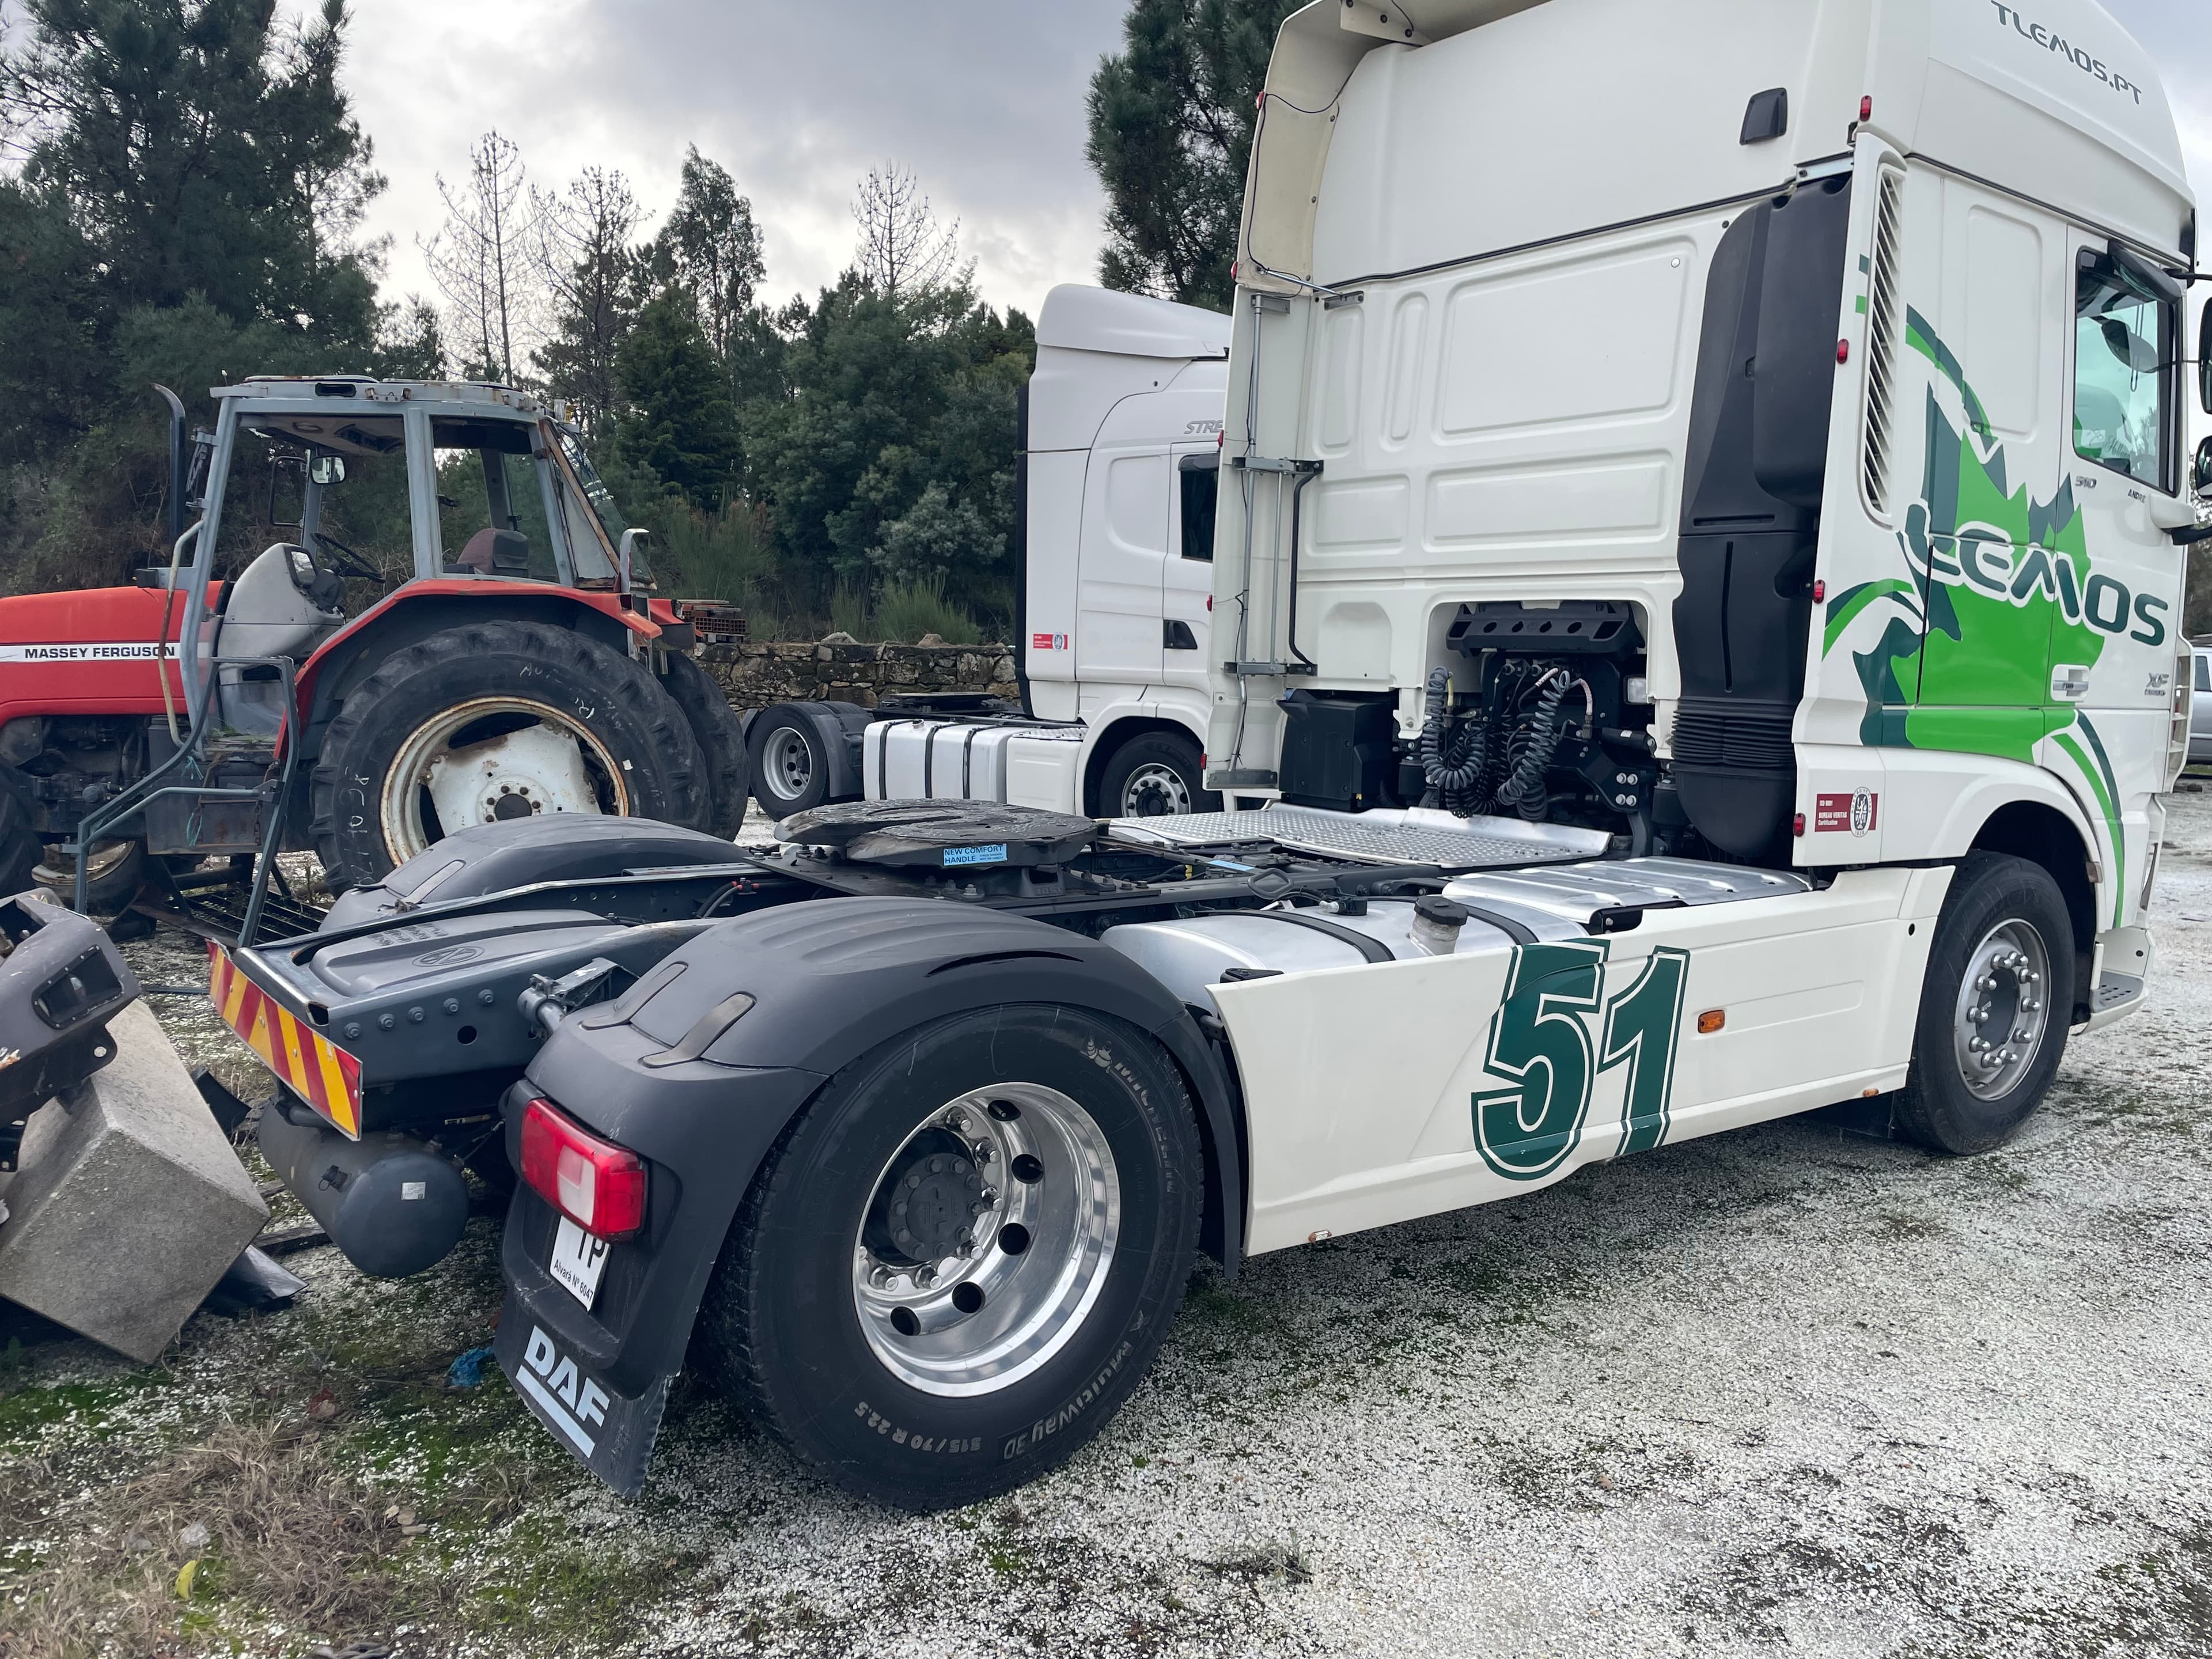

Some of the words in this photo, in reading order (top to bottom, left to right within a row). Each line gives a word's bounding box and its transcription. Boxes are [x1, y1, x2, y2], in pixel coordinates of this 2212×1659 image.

[2075, 476, 2097, 488] 510
[1905, 503, 2168, 646] LEMOS
[25, 647, 88, 658] MASSEY
[93, 646, 175, 657] FERGUSON
[2146, 672, 2169, 687] XF
[964, 846, 1002, 854] COMFORT
[945, 855, 976, 863] HANDLE
[1470, 937, 1690, 1181] 51
[554, 1259, 571, 1282] Alvará
[579, 1282, 594, 1302] 6047
[524, 1325, 610, 1427] DAF
[854, 1401, 891, 1434] 22.5
[892, 1428, 908, 1445] R
[911, 1435, 981, 1453] 315/70
